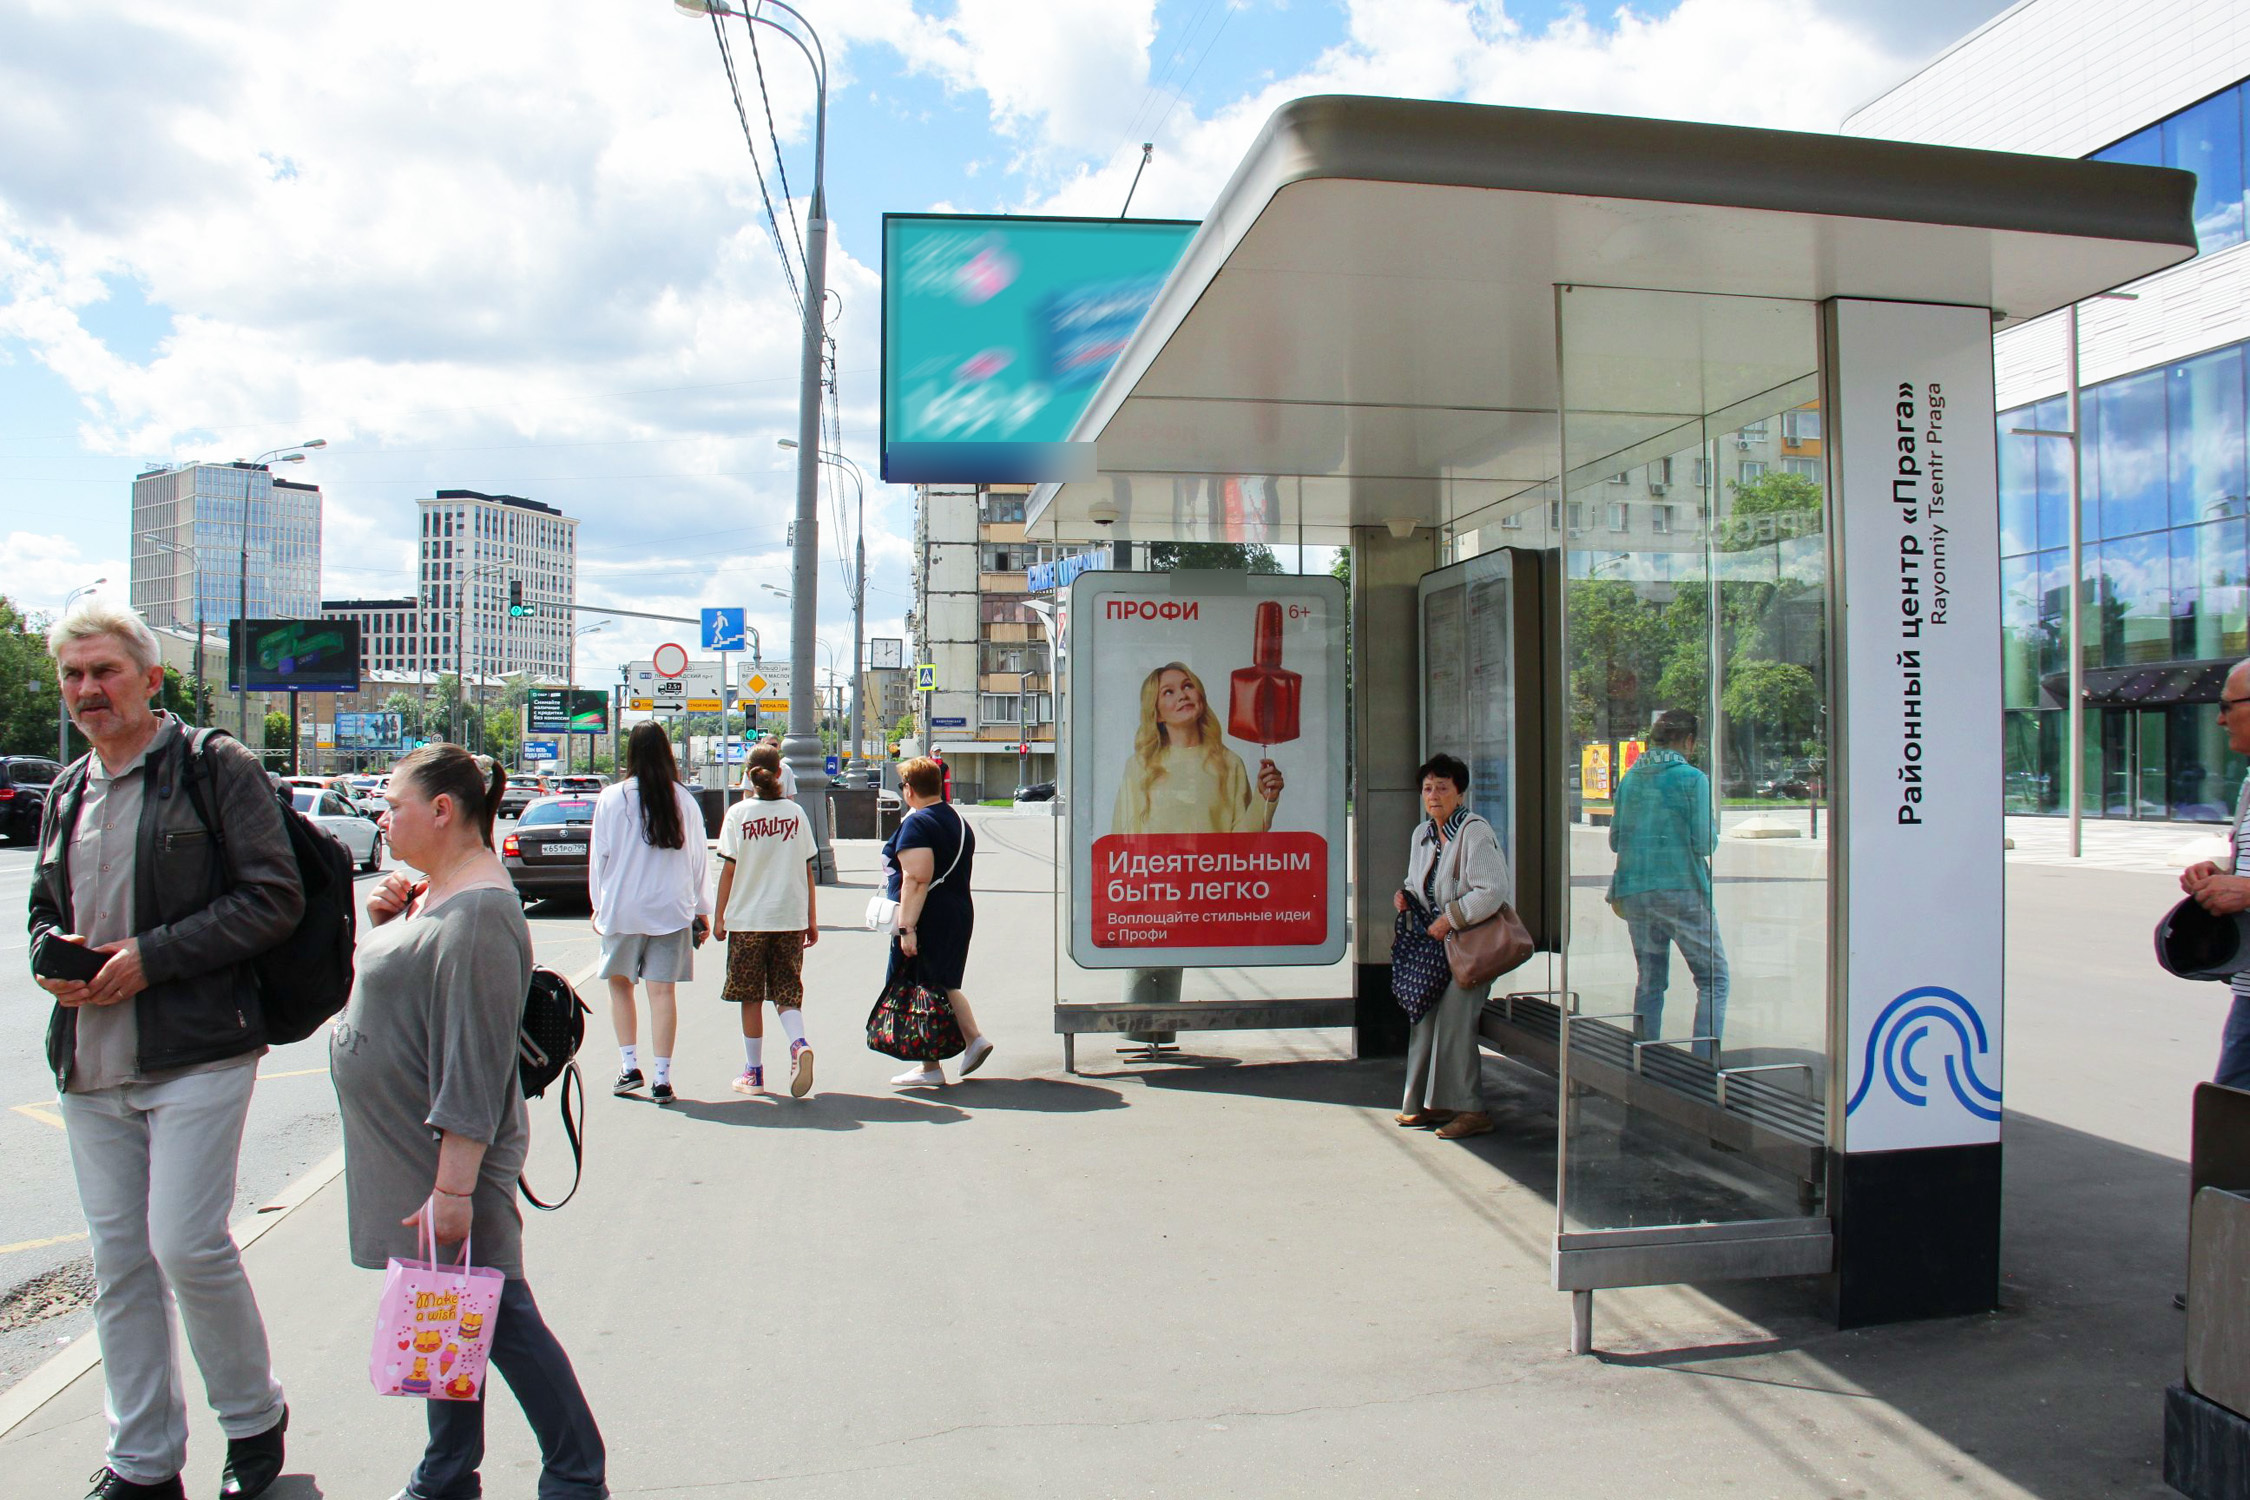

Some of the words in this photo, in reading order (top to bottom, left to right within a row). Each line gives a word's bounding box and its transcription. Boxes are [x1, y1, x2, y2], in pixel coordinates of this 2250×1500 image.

[1926, 383, 1947, 444] Praga
[1892, 380, 1923, 525] «Прага»
[1927, 451, 1945, 519] Tsentr
[1900, 534, 1924, 638] центр
[1929, 523, 1950, 625] Rayonniy
[1106, 600, 1199, 621] ПРОФИ
[1288, 604, 1311, 619] 6+
[1896, 650, 1923, 825] Районный
[741, 815, 800, 842] FATALITY!
[1107, 850, 1311, 878] Идеятельным
[1107, 878, 1182, 903] быть
[1187, 882, 1270, 900] легко
[1107, 911, 1199, 926] Воплощайте
[1202, 910, 1273, 923] стильные
[1275, 911, 1311, 923] идеи
[1107, 931, 1116, 941] с
[1119, 928, 1167, 943] Профи
[415, 1290, 459, 1310] Make
[415, 1311, 424, 1322] a
[426, 1306, 458, 1321] wish
